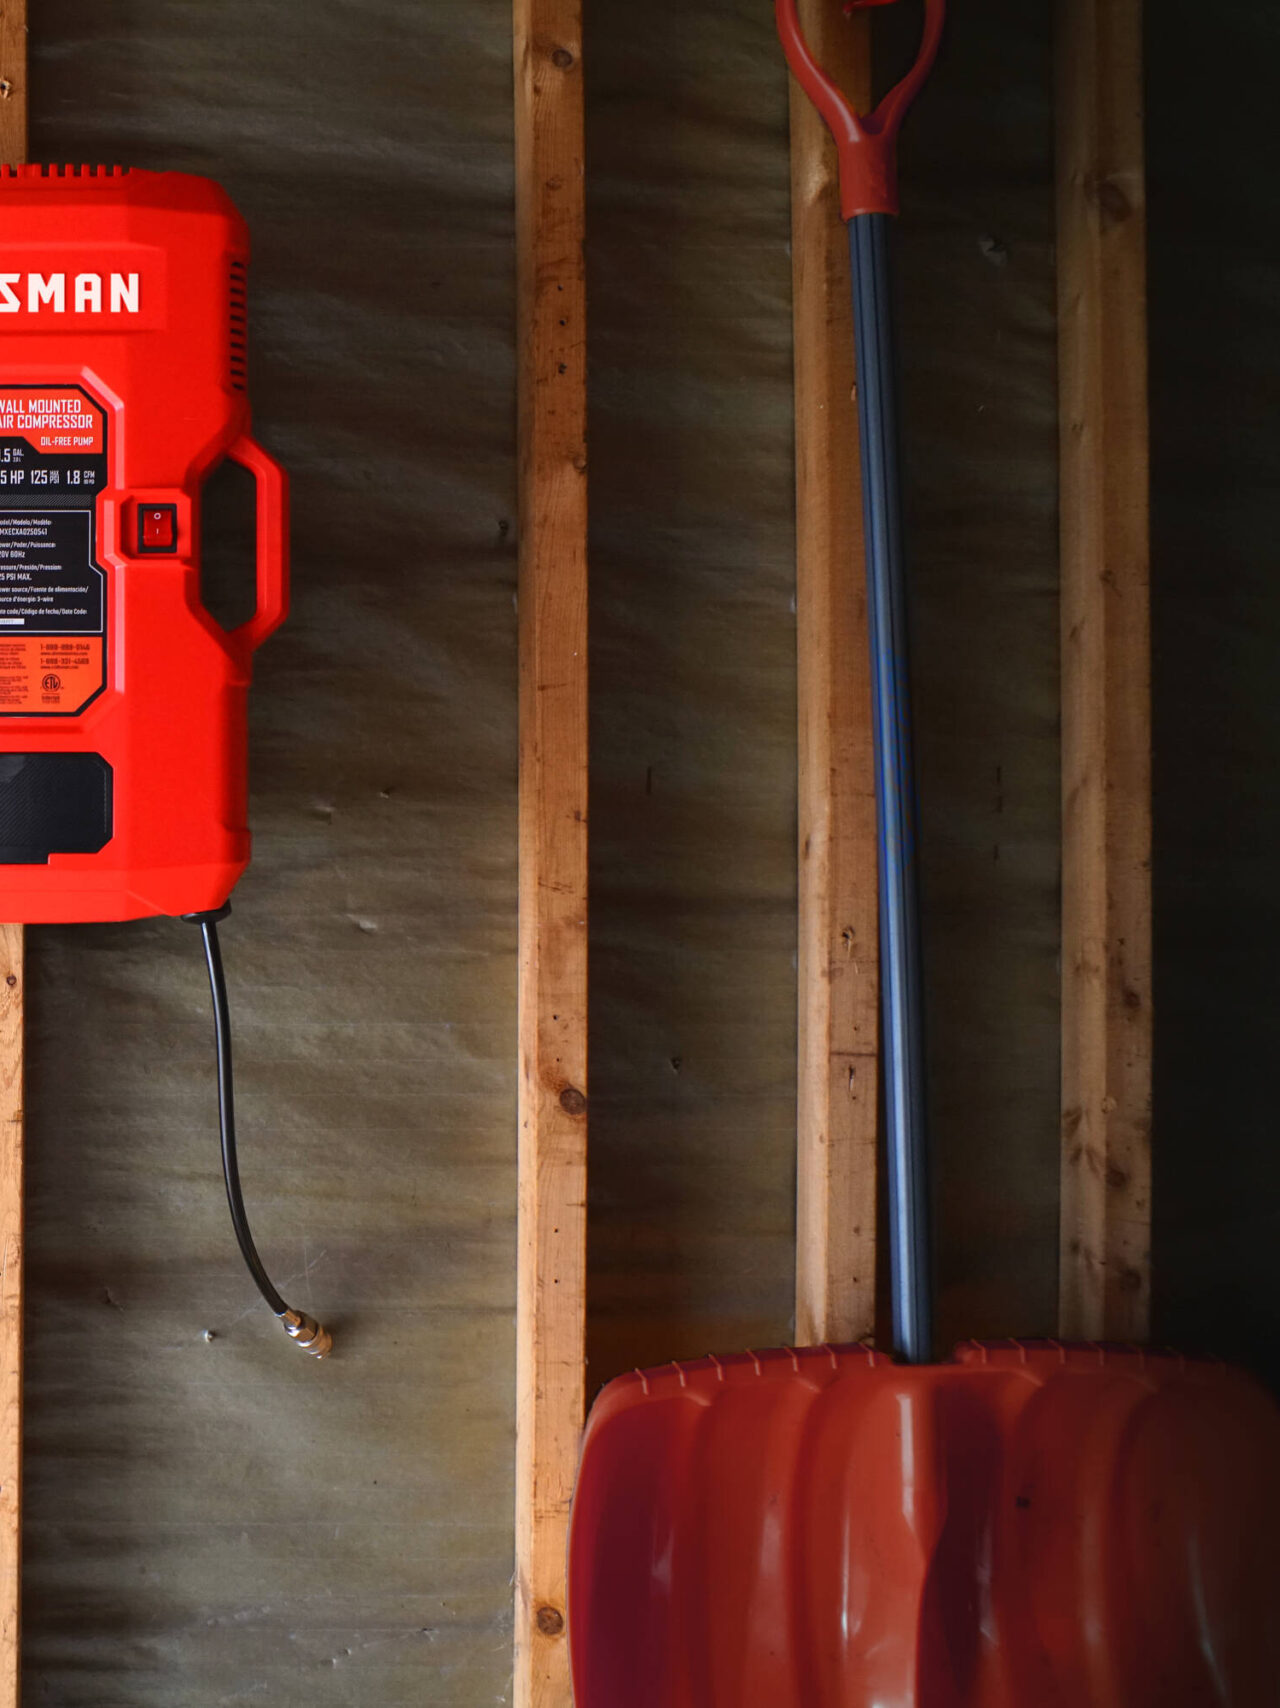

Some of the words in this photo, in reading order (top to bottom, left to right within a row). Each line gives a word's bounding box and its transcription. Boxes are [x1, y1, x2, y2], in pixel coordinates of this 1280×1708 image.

[28, 399, 81, 414] MOUNTED
[17, 414, 93, 429] COMPRESSOR
[40, 436, 71, 446] OIL-FREE
[73, 436, 94, 446] PUMP
[10, 470, 24, 484] HP
[30, 470, 48, 484] 125
[67, 470, 80, 484] 1.8
